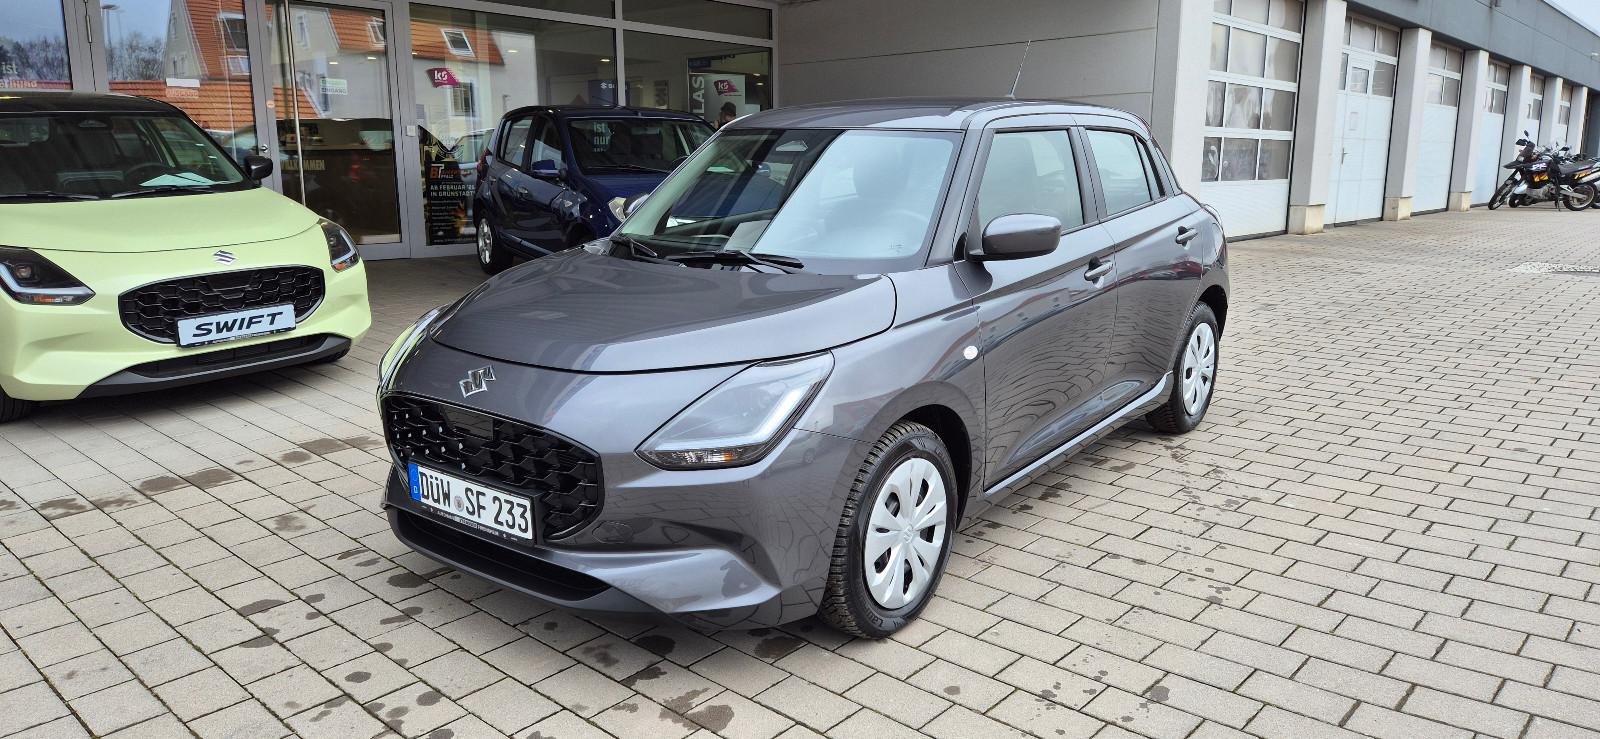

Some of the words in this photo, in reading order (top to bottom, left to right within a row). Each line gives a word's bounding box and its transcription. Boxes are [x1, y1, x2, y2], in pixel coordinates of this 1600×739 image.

[2, 62, 18, 74] ist
[593, 136, 610, 145] nur
[192, 311, 283, 338] SWIFT
[419, 471, 451, 509] DÜW
[464, 487, 487, 519] SF
[493, 495, 529, 534] 233
